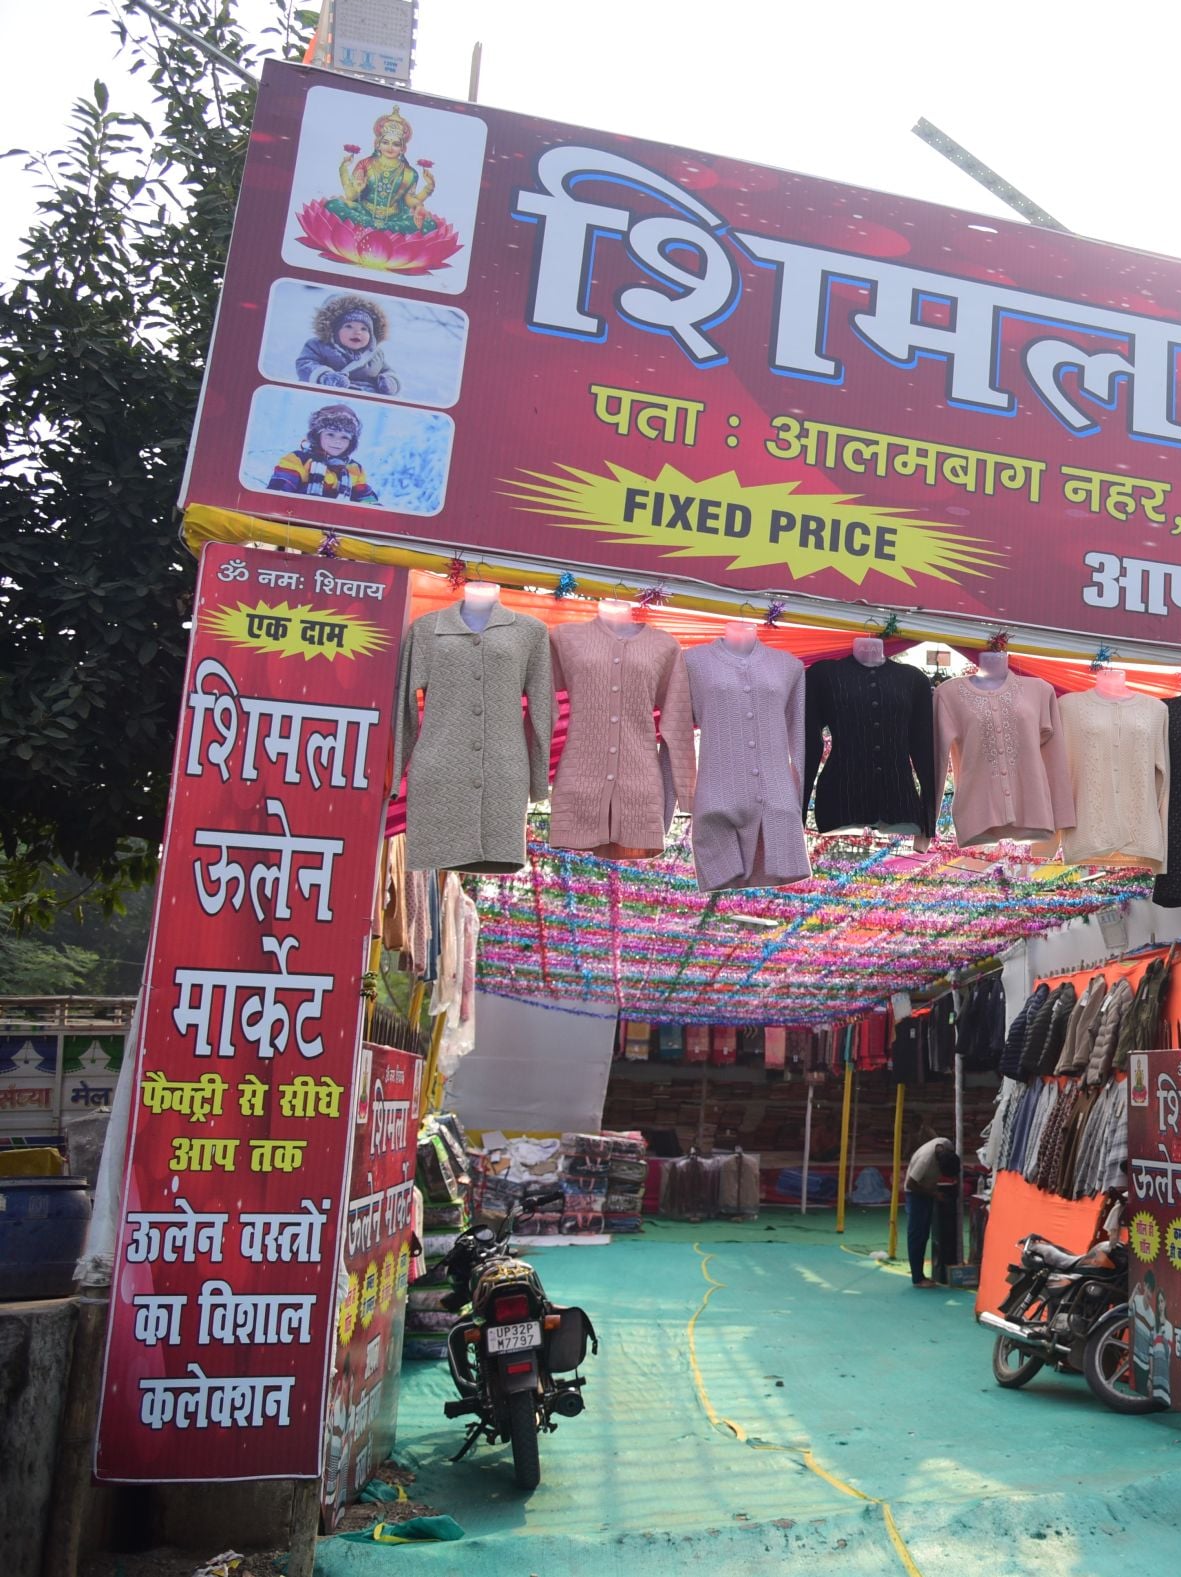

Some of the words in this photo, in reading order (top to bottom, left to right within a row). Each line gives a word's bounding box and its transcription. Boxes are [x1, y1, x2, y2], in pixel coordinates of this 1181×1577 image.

[590, 383, 706, 446] पता
[764, 412, 1048, 505] आलमबाग
[622, 487, 752, 538] FIXED
[769, 509, 898, 563] PRICE
[257, 568, 305, 591] नमः
[314, 569, 386, 601] शिवाय
[246, 612, 292, 641] एक
[300, 619, 348, 648] दाम
[186, 657, 381, 790] शिमला
[193, 798, 344, 922] ऊलेन
[172, 936, 335, 1060] मार्केट
[140, 1071, 229, 1123] फैक्ट्री
[238, 1074, 269, 1116] से
[279, 1075, 344, 1118] सीधे
[169, 1137, 240, 1172] आप
[249, 1140, 307, 1172] तक
[126, 1198, 229, 1263] ऊलेन
[239, 1198, 331, 1263] वस्त्रों
[133, 1295, 187, 1346] का
[198, 1280, 316, 1345] विशाल
[496, 1323, 534, 1338] UP32P
[140, 1363, 296, 1430] कलेक्शन
